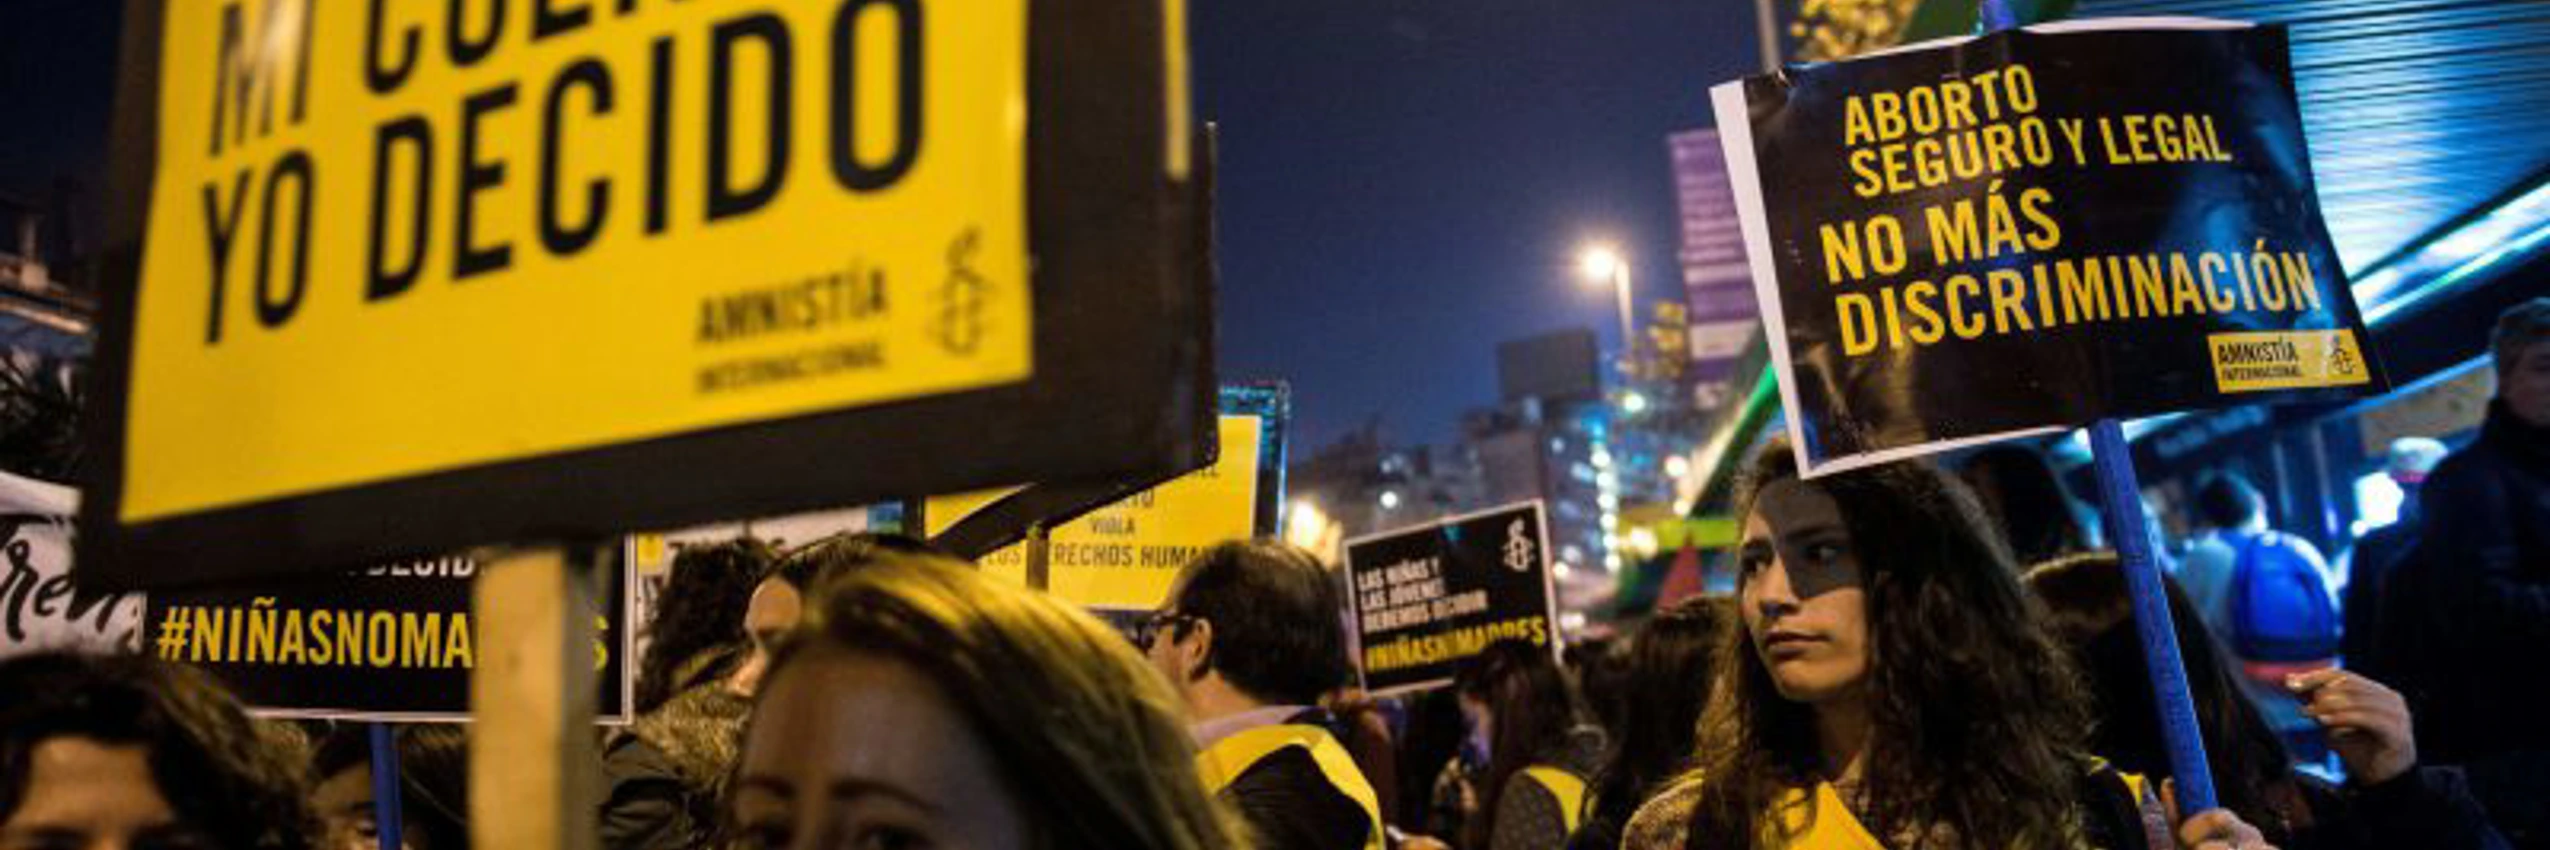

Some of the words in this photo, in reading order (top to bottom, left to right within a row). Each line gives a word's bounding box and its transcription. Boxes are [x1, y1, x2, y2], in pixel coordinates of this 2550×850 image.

[1844, 64, 2038, 146] ABORTO
[202, 150, 315, 346] YO
[363, 0, 924, 303] DECIDO
[1850, 114, 2052, 199] SEGURO
[2057, 117, 2088, 166] Y
[2101, 114, 2232, 166] LEGAL
[1818, 215, 1908, 285] NO
[1925, 184, 2061, 265] MÁS
[696, 255, 888, 343] AMNISTÍA
[1836, 238, 2321, 357] DISCRIMINACIÓN
[2218, 335, 2299, 364] AMNISTÍA
